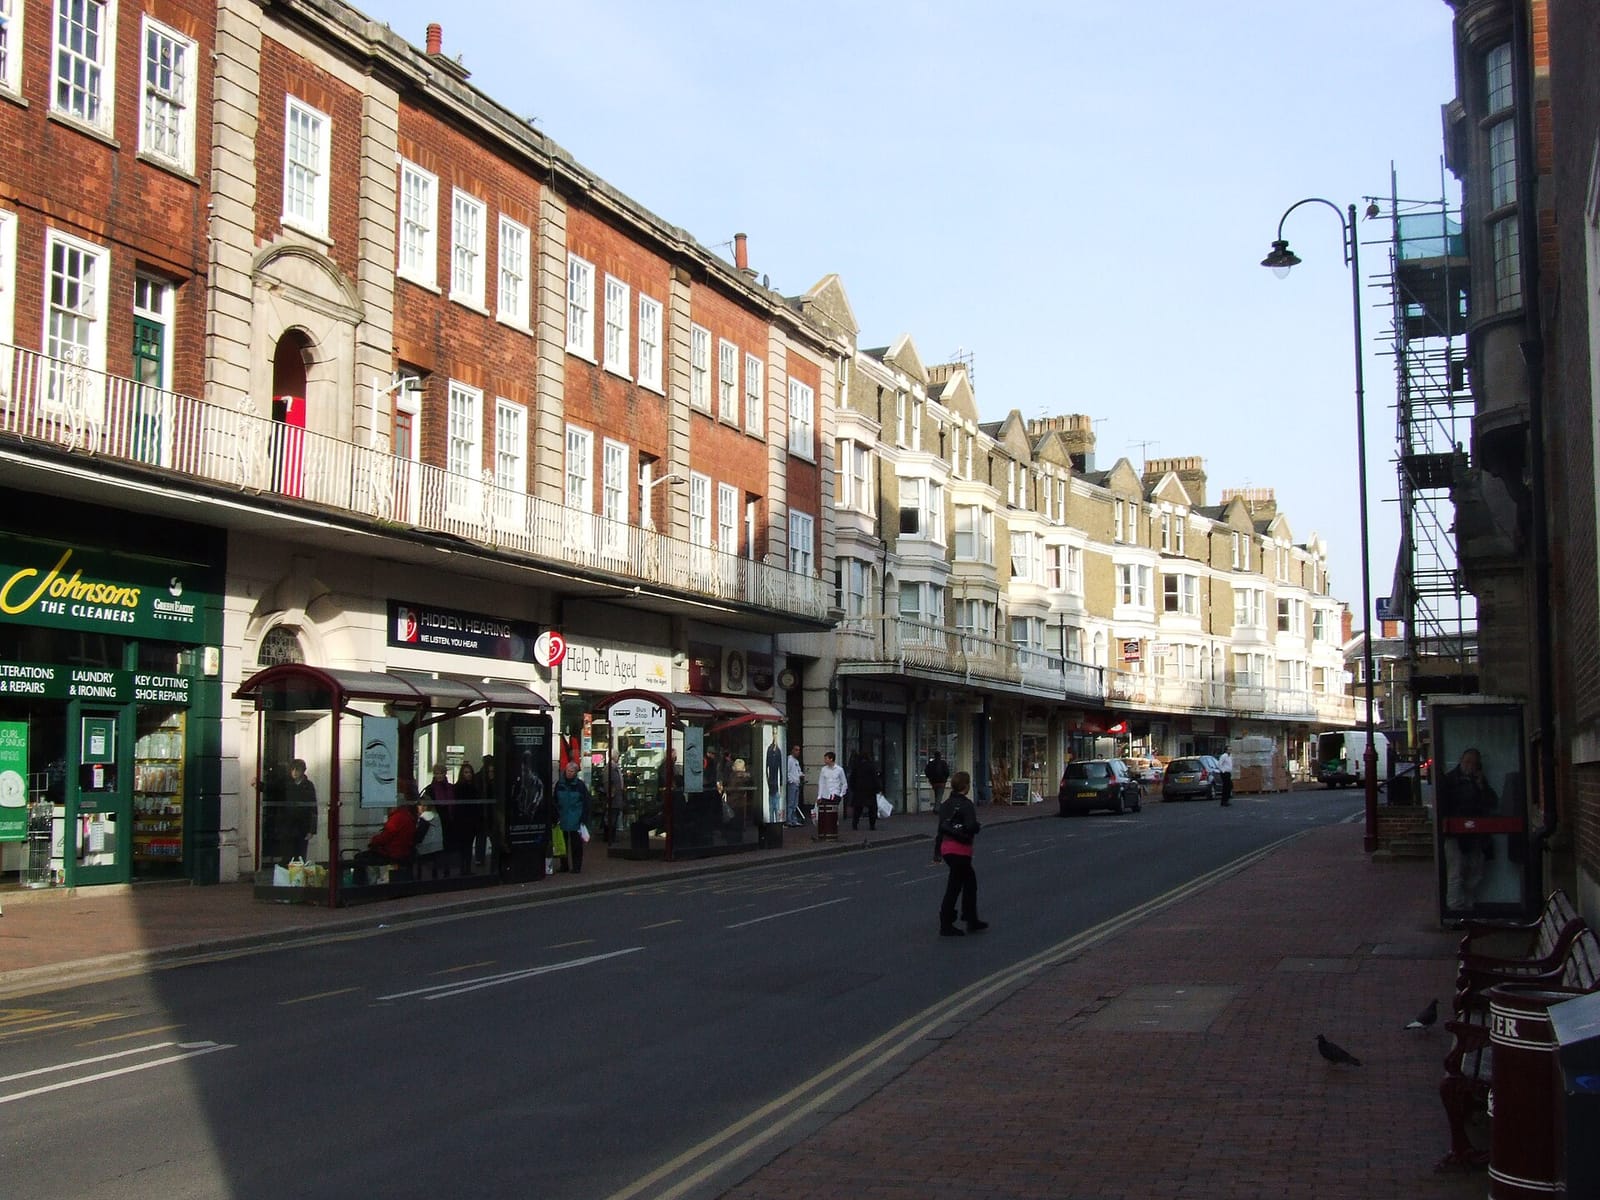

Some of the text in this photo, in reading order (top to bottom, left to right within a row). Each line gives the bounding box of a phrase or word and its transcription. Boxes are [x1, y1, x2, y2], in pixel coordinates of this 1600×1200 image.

[0, 548, 141, 615] Johnsons
[41, 600, 136, 623] THE CLEANERS
[420, 612, 511, 638] HIDDEN HEARING
[420, 634, 430, 642] WE
[451, 638, 463, 647] YOU
[462, 640, 478, 649] HEAR
[566, 647, 637, 684] Help the Aged
[72, 670, 114, 683] LAUNDRY
[135, 674, 189, 689] KEY CUTTING
[0, 680, 45, 694] & REPAIRS
[69, 684, 117, 698] & IRONING
[135, 688, 188, 702] SHOE REPAIRS
[652, 706, 662, 717] M
[5, 738, 26, 748] SNUG
